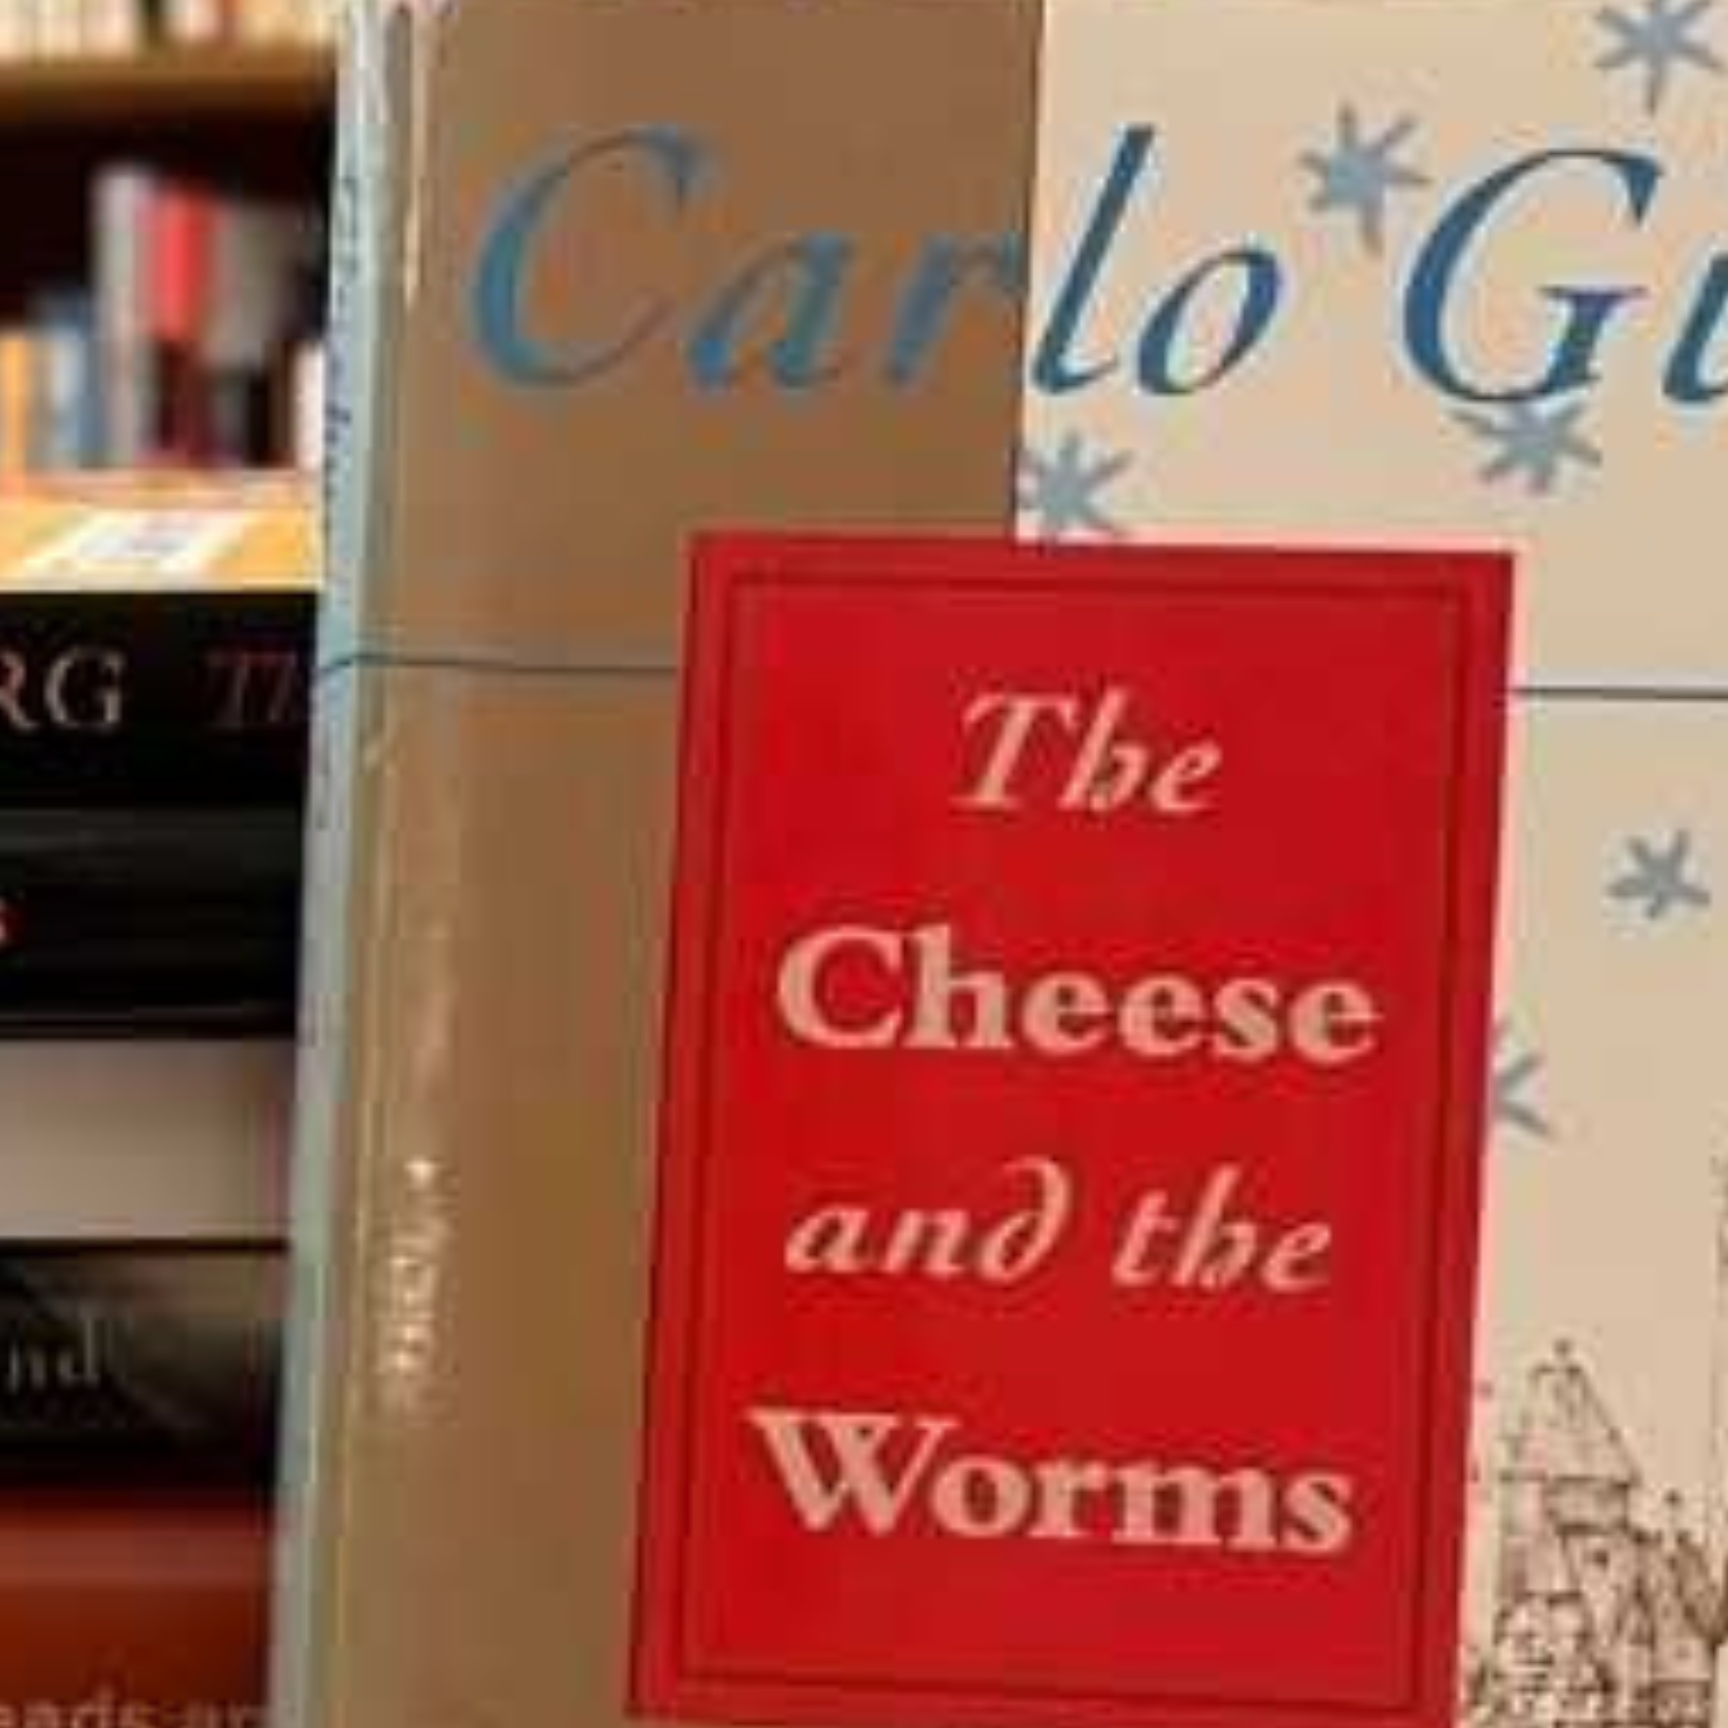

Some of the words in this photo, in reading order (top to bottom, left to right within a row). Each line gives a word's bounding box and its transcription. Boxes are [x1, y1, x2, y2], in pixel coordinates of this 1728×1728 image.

[467, 122, 1284, 402] Carlo
[946, 686, 1224, 814] The
[776, 924, 1384, 1062] Cheese
[782, 1157, 1073, 1283] and
[1110, 1164, 1334, 1293] the
[746, 1406, 1355, 1557] Worms
